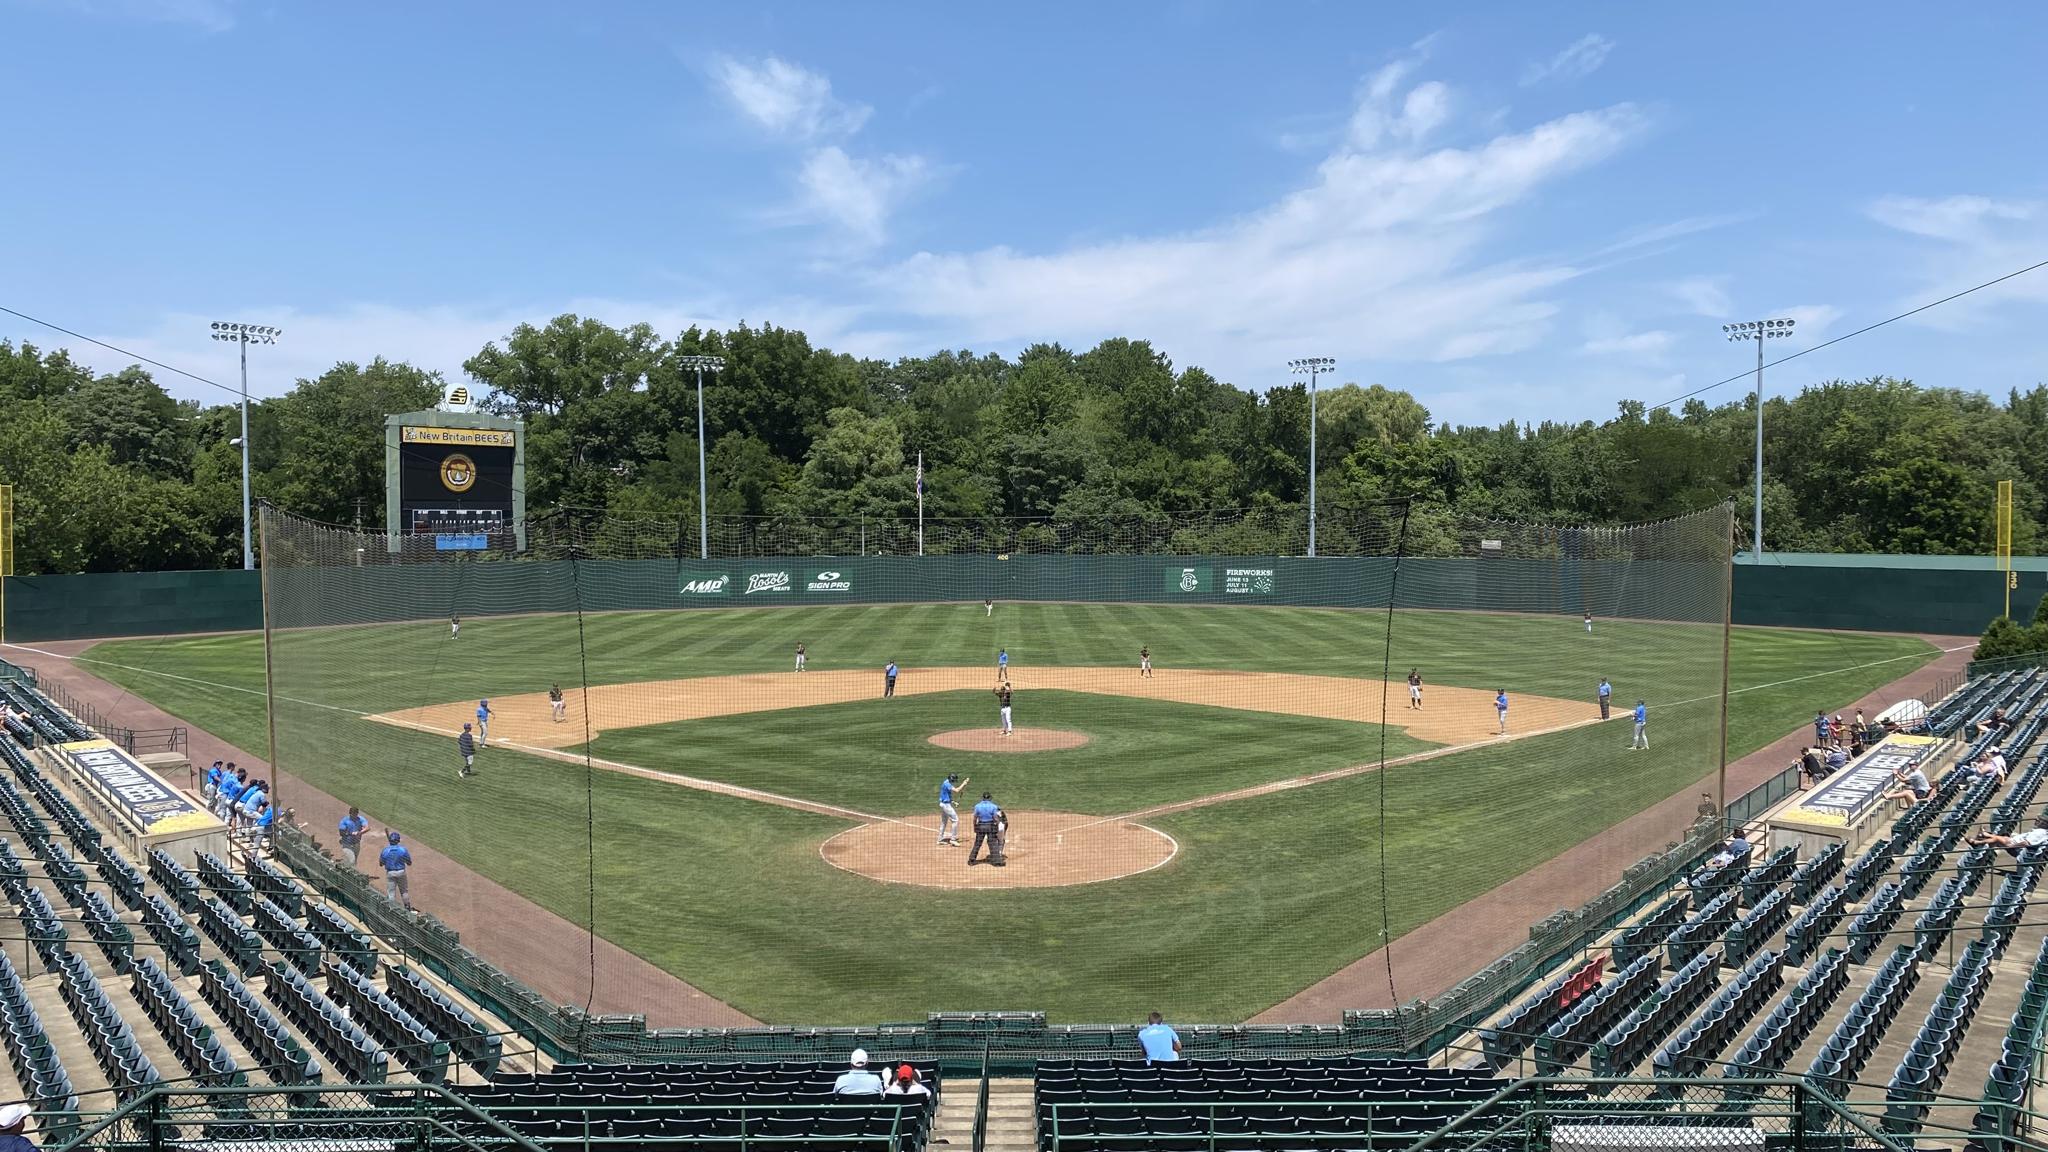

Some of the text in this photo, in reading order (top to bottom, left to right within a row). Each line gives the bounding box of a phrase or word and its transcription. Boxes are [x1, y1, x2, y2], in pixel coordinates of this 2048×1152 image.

[419, 431, 499, 443] New Britain BEES
[680, 580, 723, 593] AMP
